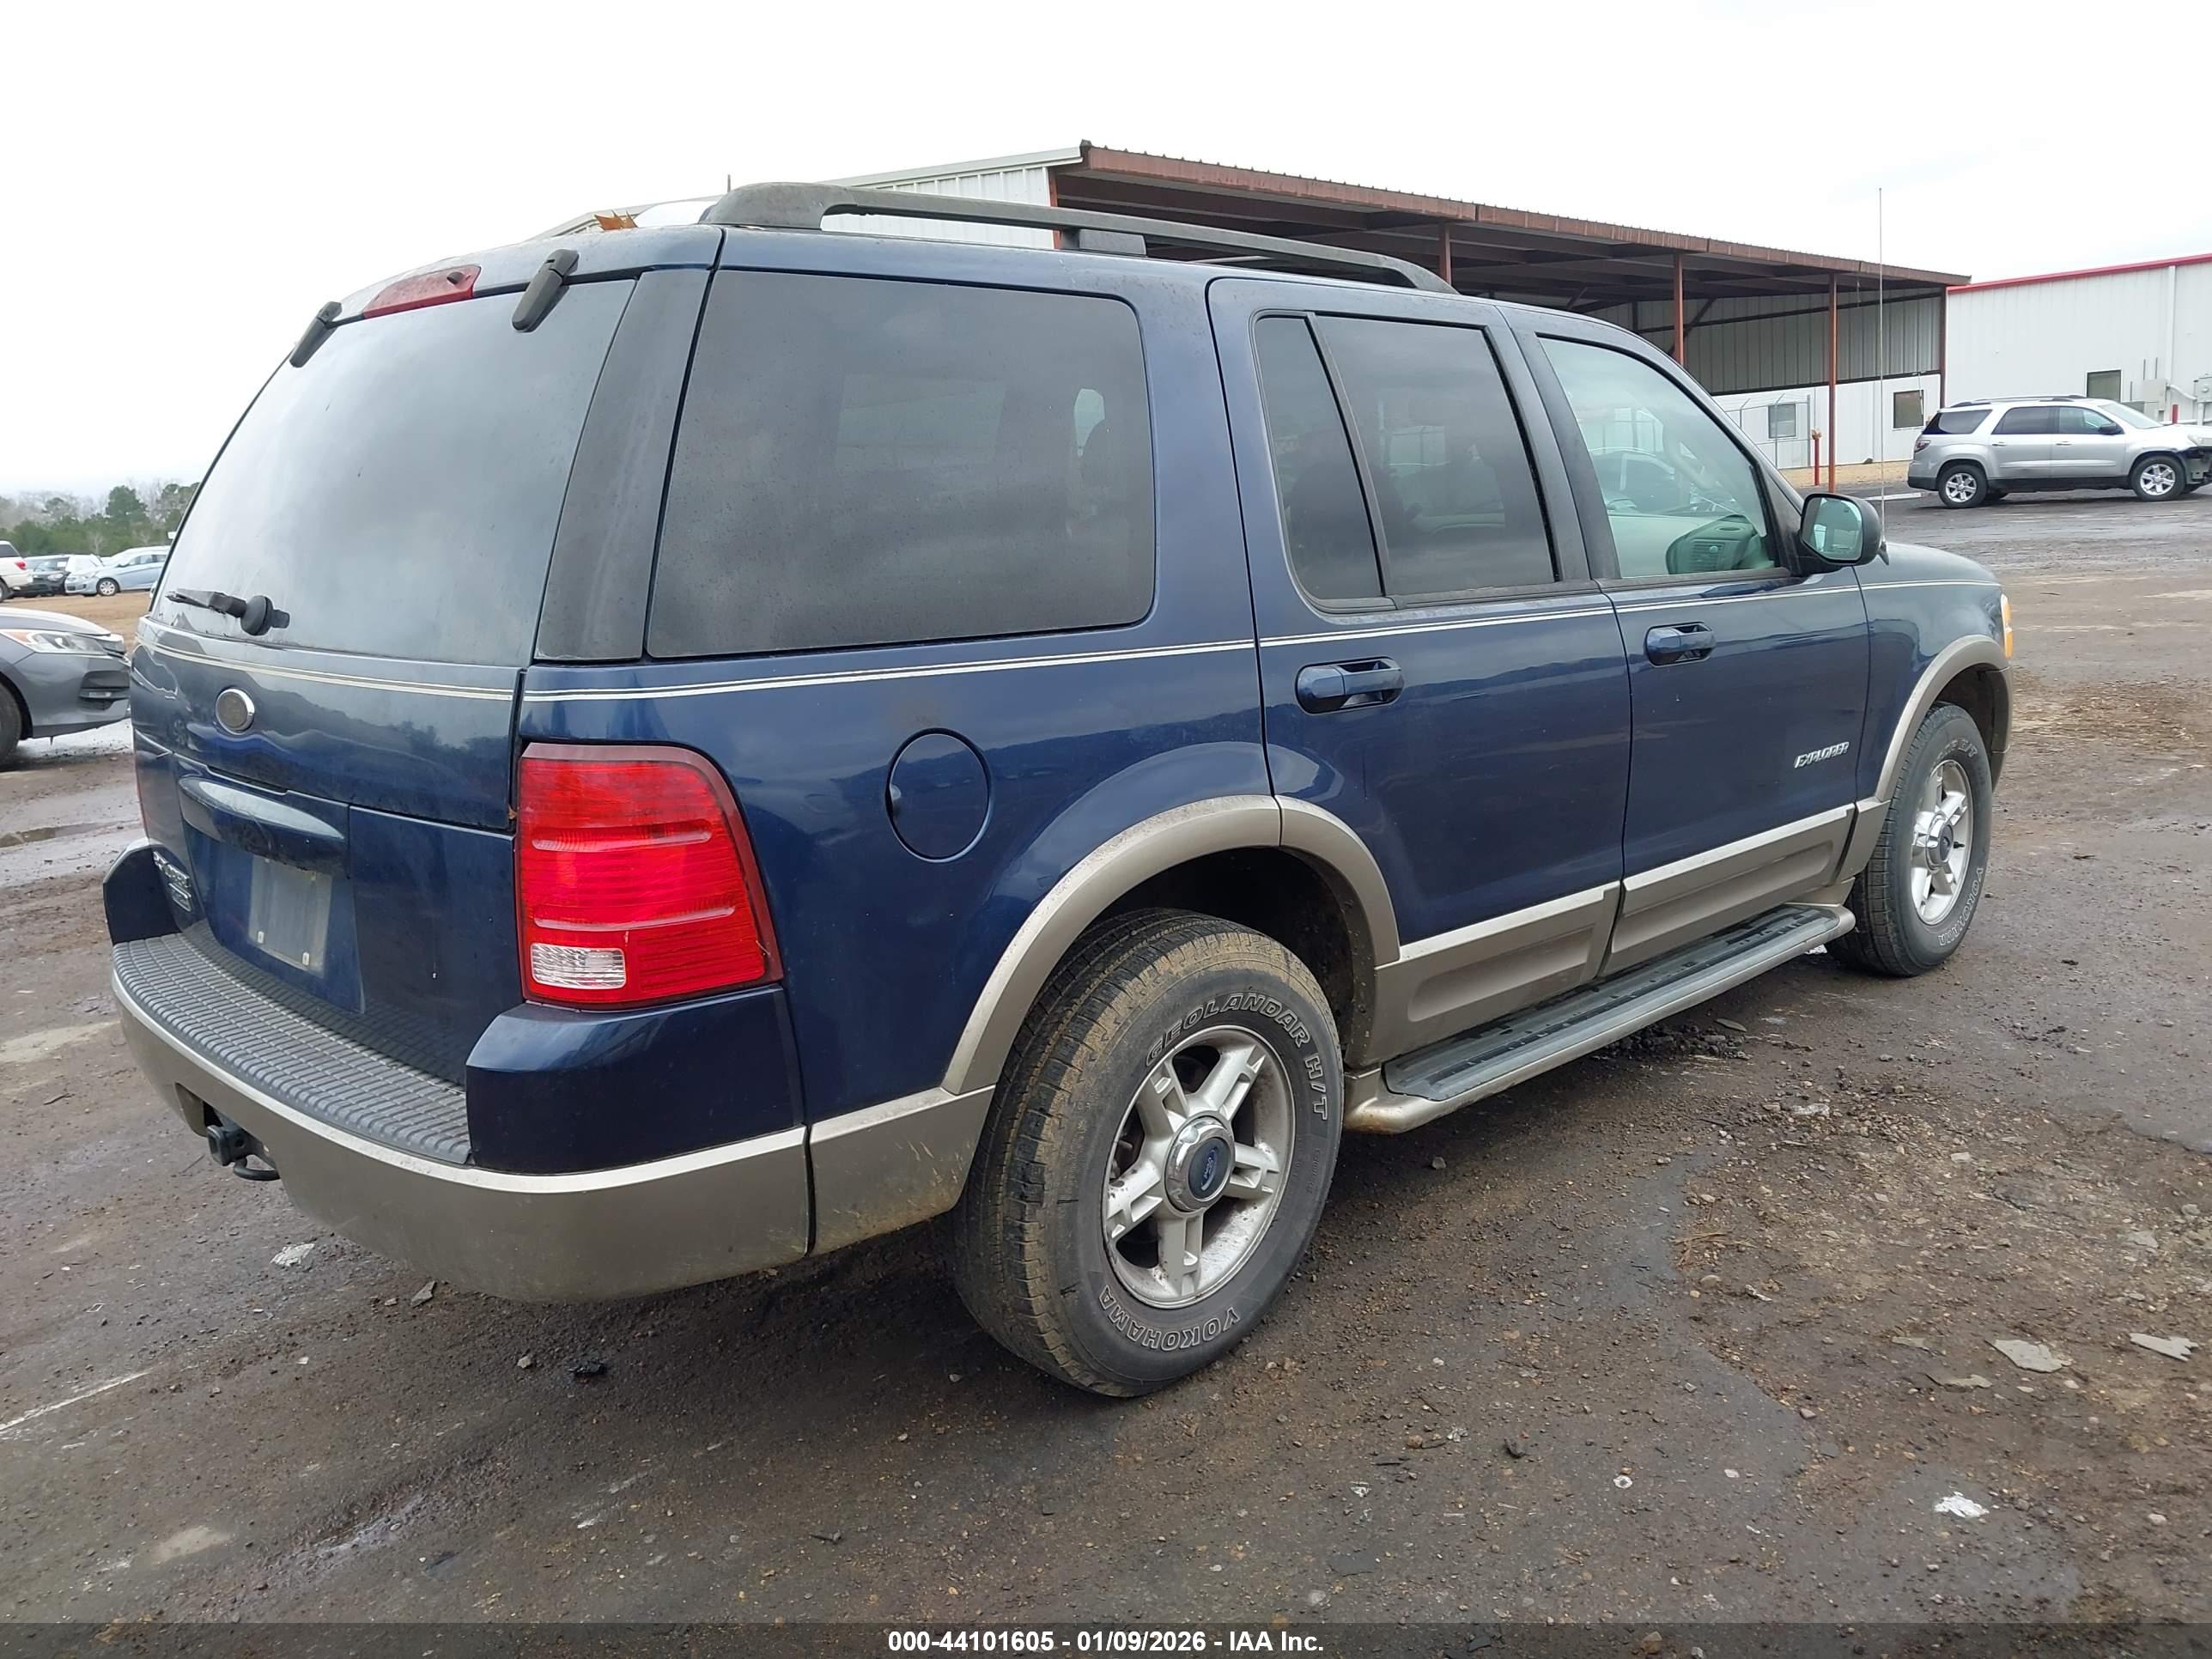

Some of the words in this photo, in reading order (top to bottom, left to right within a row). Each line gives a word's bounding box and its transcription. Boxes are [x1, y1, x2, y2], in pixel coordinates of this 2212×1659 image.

[1146, 992, 1310, 1066] GEOLANDAR
[1304, 1052, 1328, 1121] H/T
[1098, 1284, 1241, 1352] YOKOHAMA
